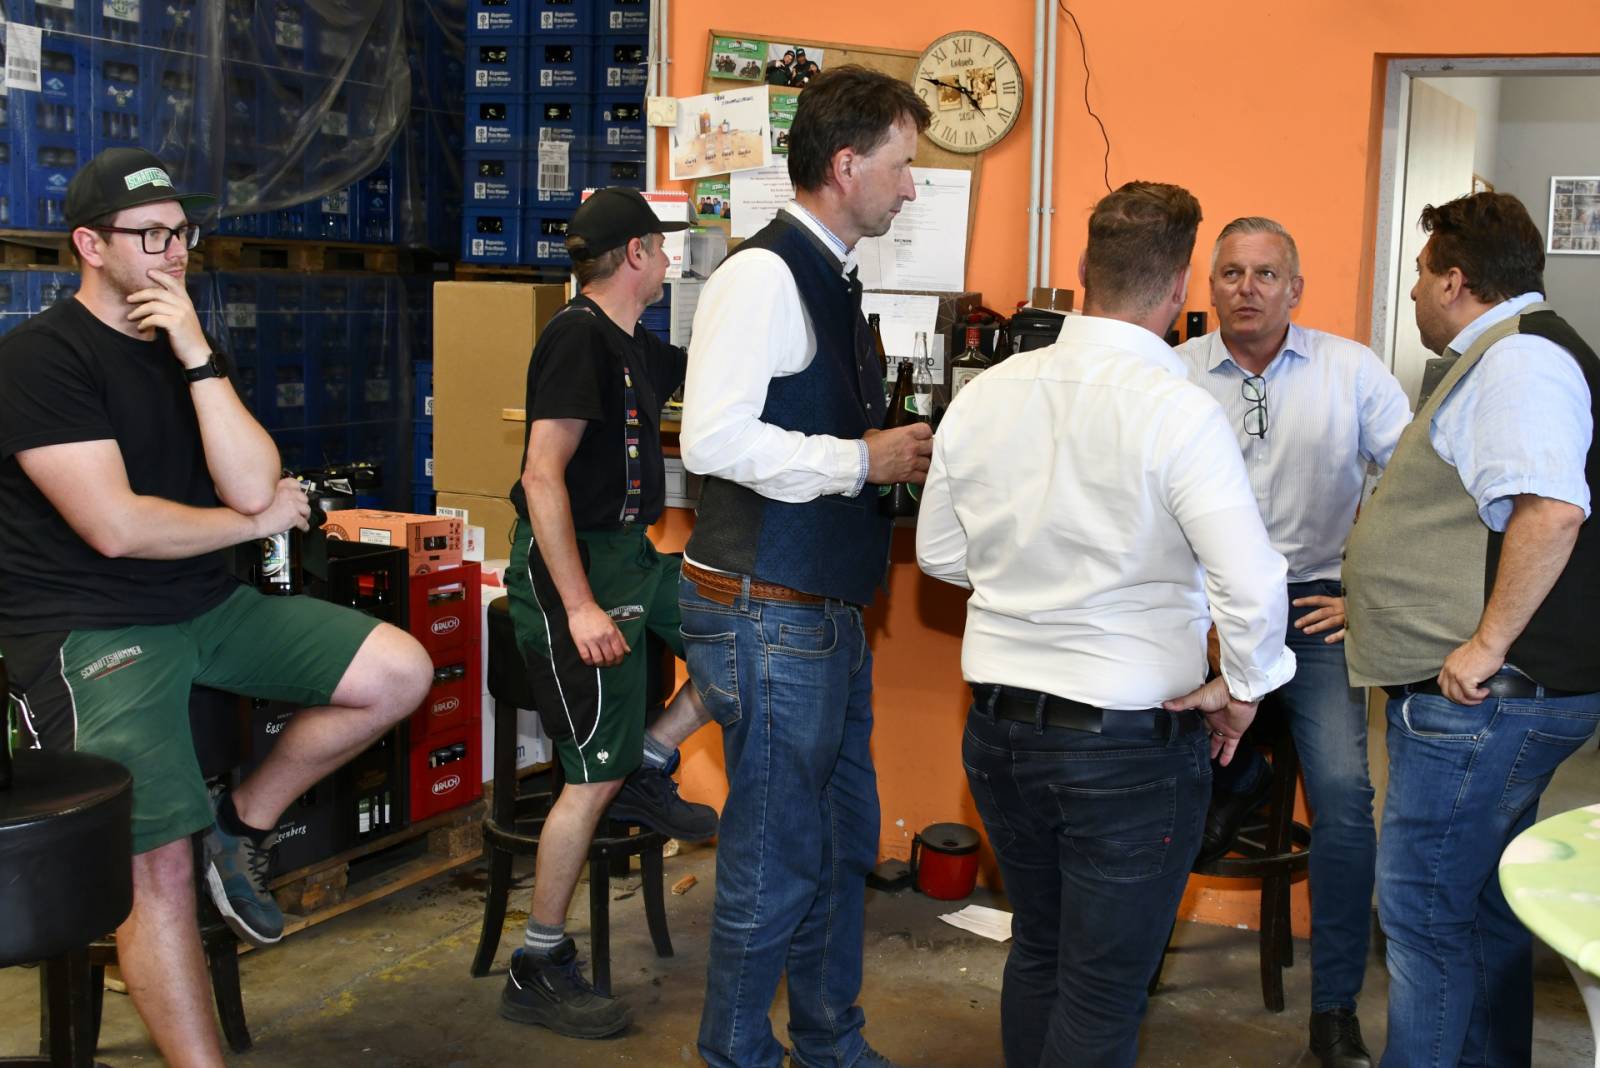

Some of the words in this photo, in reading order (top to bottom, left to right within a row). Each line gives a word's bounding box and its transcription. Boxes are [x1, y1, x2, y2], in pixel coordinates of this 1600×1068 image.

[952, 38, 973, 54] XII
[931, 47, 947, 65] XI
[994, 56, 1008, 70] II
[1002, 80, 1016, 95] III
